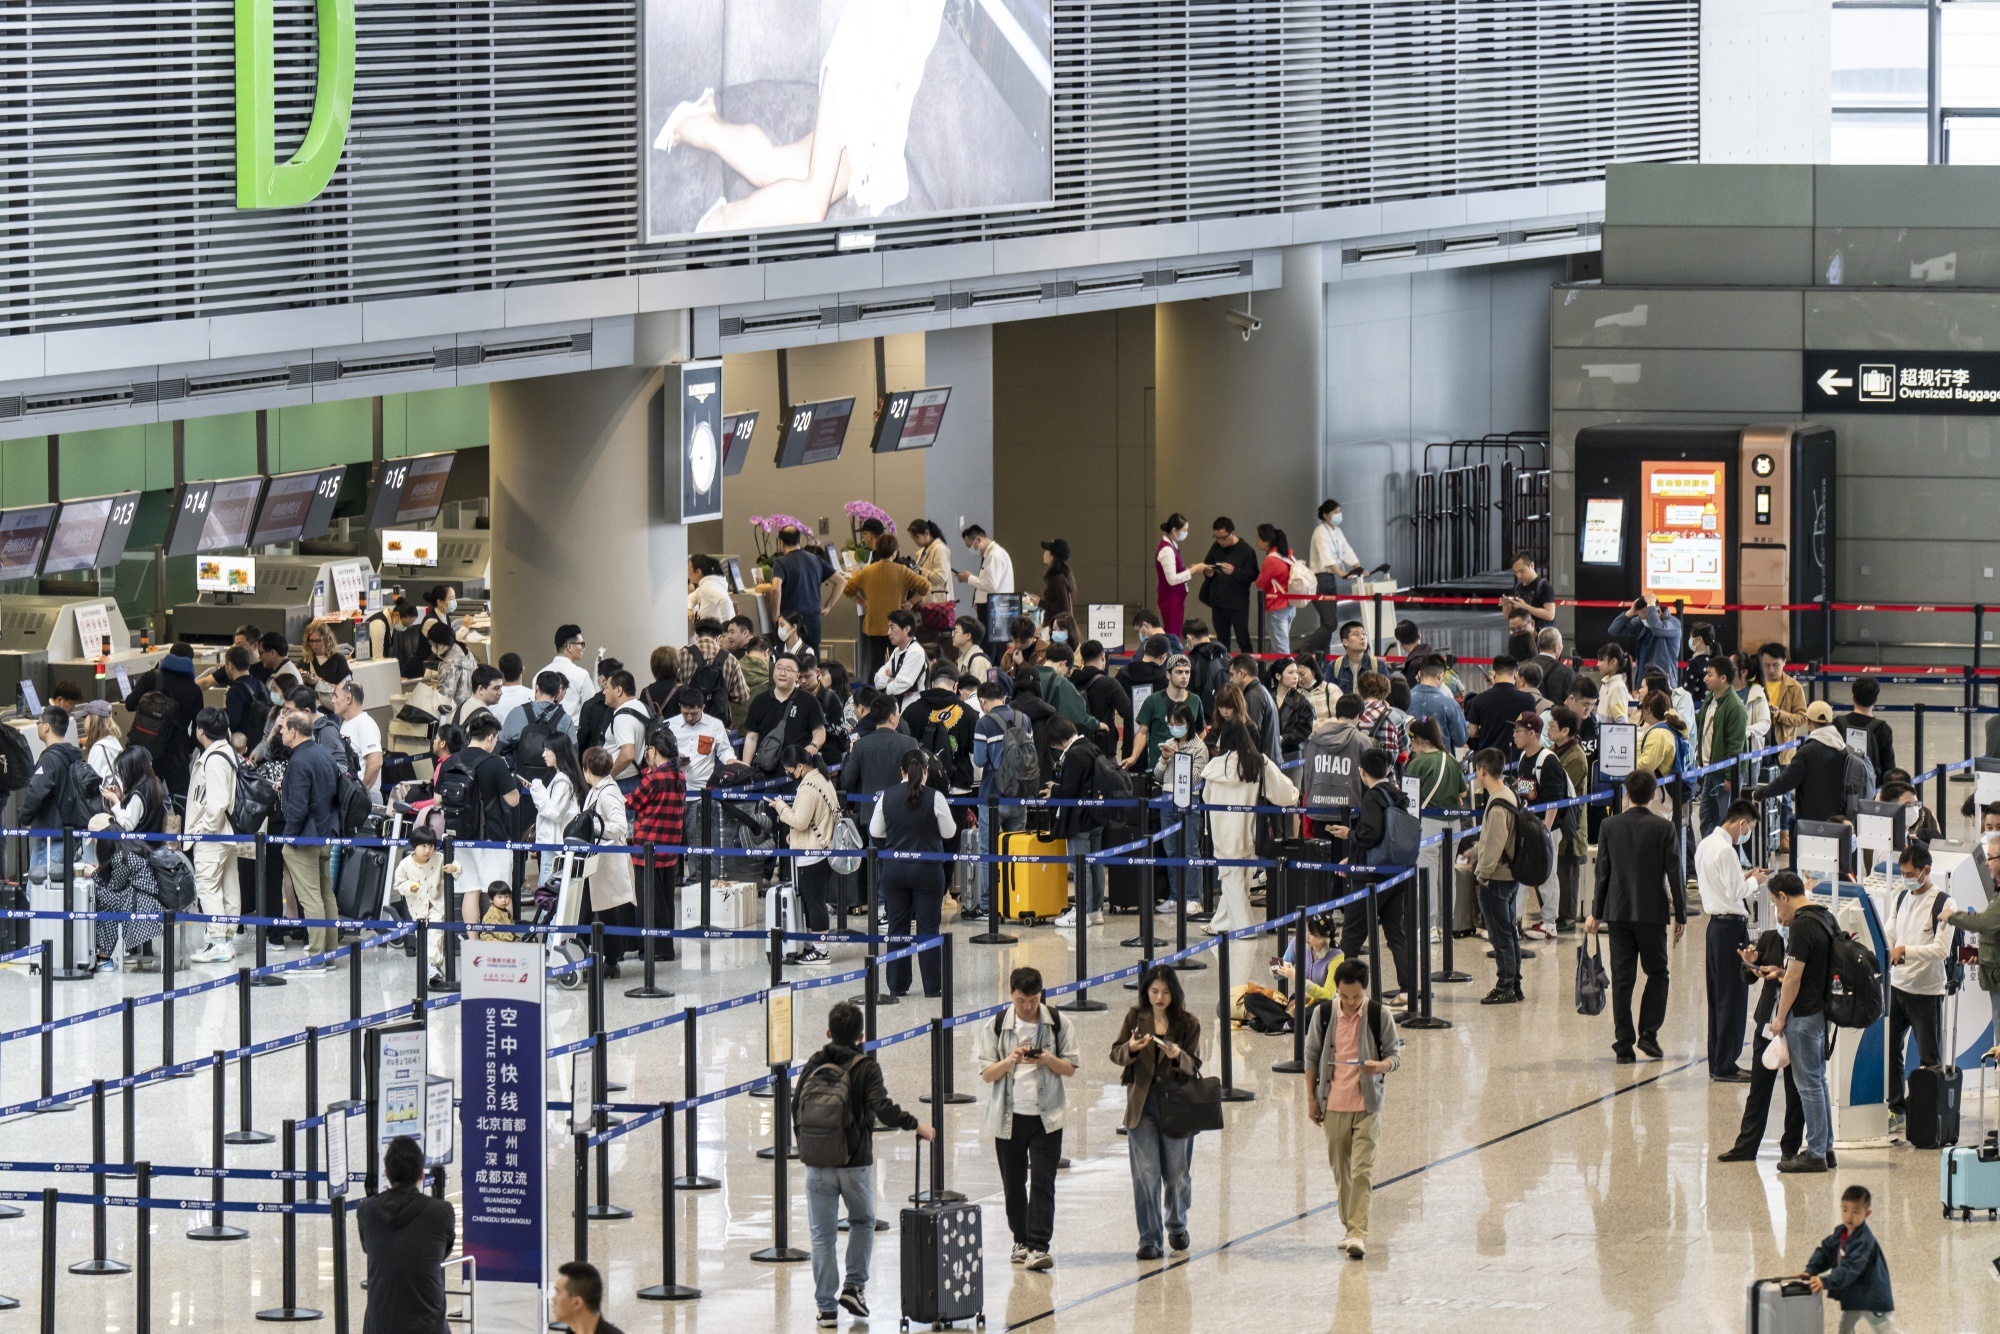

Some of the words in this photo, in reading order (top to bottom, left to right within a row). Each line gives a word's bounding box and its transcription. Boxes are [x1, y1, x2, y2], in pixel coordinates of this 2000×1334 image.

[234, 0, 356, 209] D
[1900, 368, 1970, 387] 超规行李
[1900, 387, 1953, 399] Oversized
[890, 399, 909, 420] D21
[736, 419, 755, 440] D19
[793, 411, 812, 432] D20
[319, 475, 341, 498] D15
[385, 466, 407, 489] D16
[184, 490, 209, 514] D14
[112, 502, 135, 526] D13
[1097, 620, 1116, 630] 出口
[1609, 745, 1627, 755] 入口
[486, 1007, 496, 1059] SHUTTLE
[500, 1007, 519, 1112] 空中快线
[486, 1061, 497, 1112] SERVICE
[476, 1116, 527, 1132] 北京首都
[475, 1169, 528, 1186] 成都双流
[478, 1186, 502, 1195] BEIJING
[502, 1187, 527, 1196] CAPITAL
[483, 1196, 522, 1205] GUANGZHOU
[472, 1215, 500, 1223] CHENGDU
[486, 1206, 517, 1214] SHENZHEN
